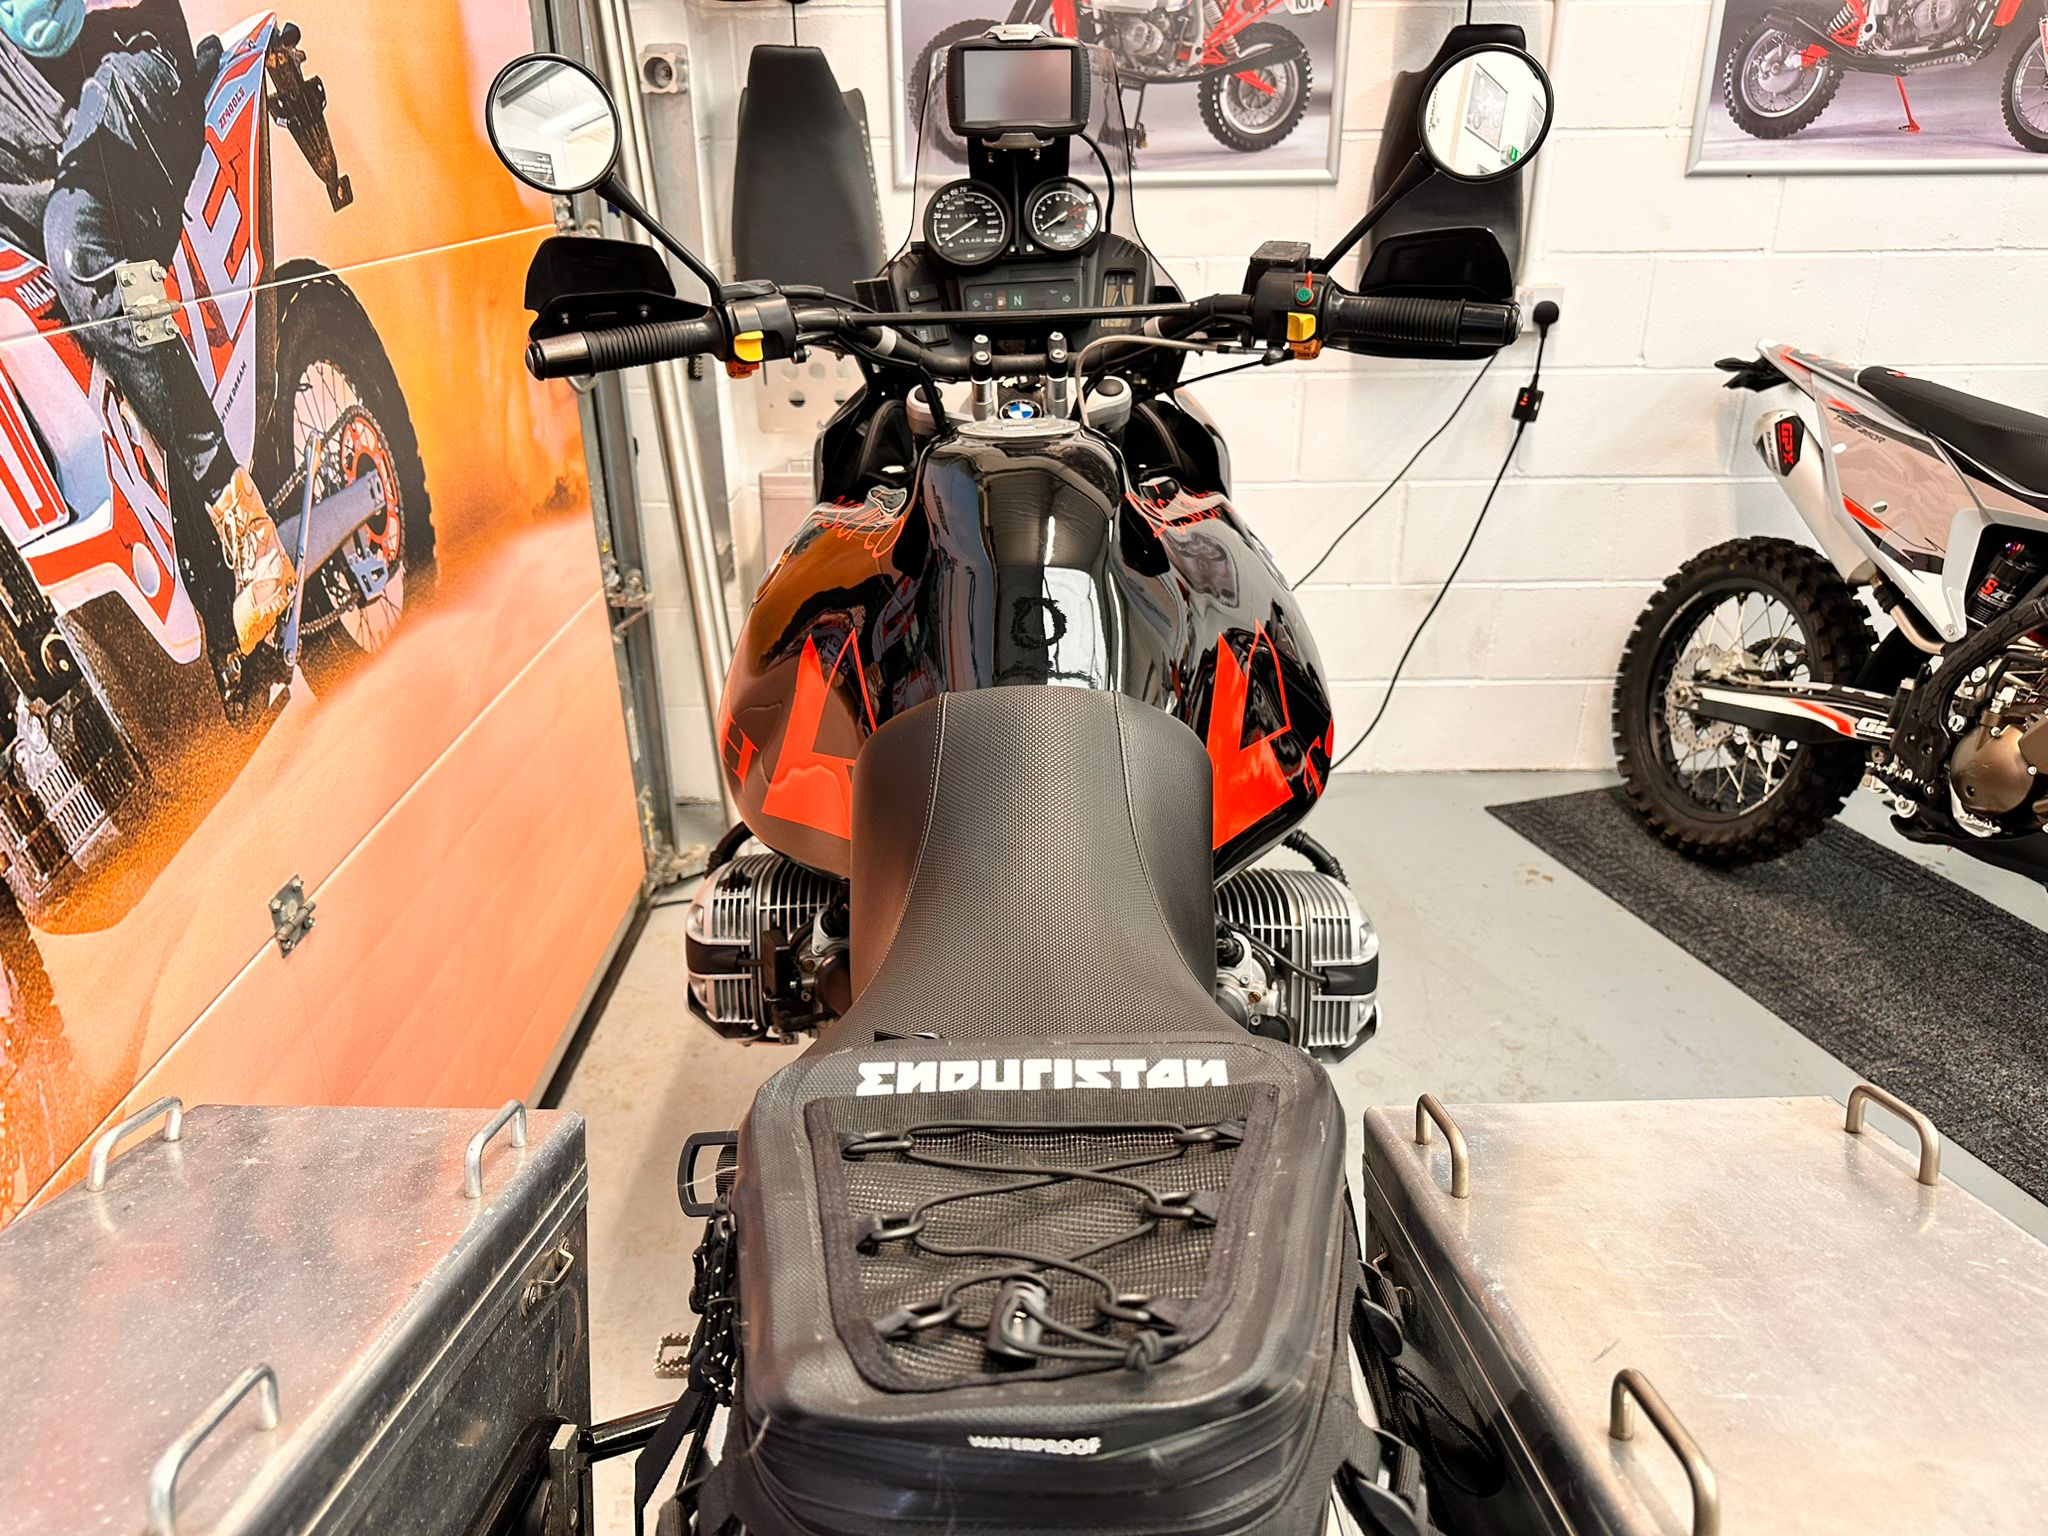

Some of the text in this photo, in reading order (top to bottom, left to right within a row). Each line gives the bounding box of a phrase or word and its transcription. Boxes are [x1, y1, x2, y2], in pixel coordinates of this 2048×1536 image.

[1013, 295, 1022, 306] N
[1780, 421, 1794, 466] GPX
[855, 1058, 1230, 1097] ENDURISTAN
[967, 1434, 1102, 1456] WATERPROOF
